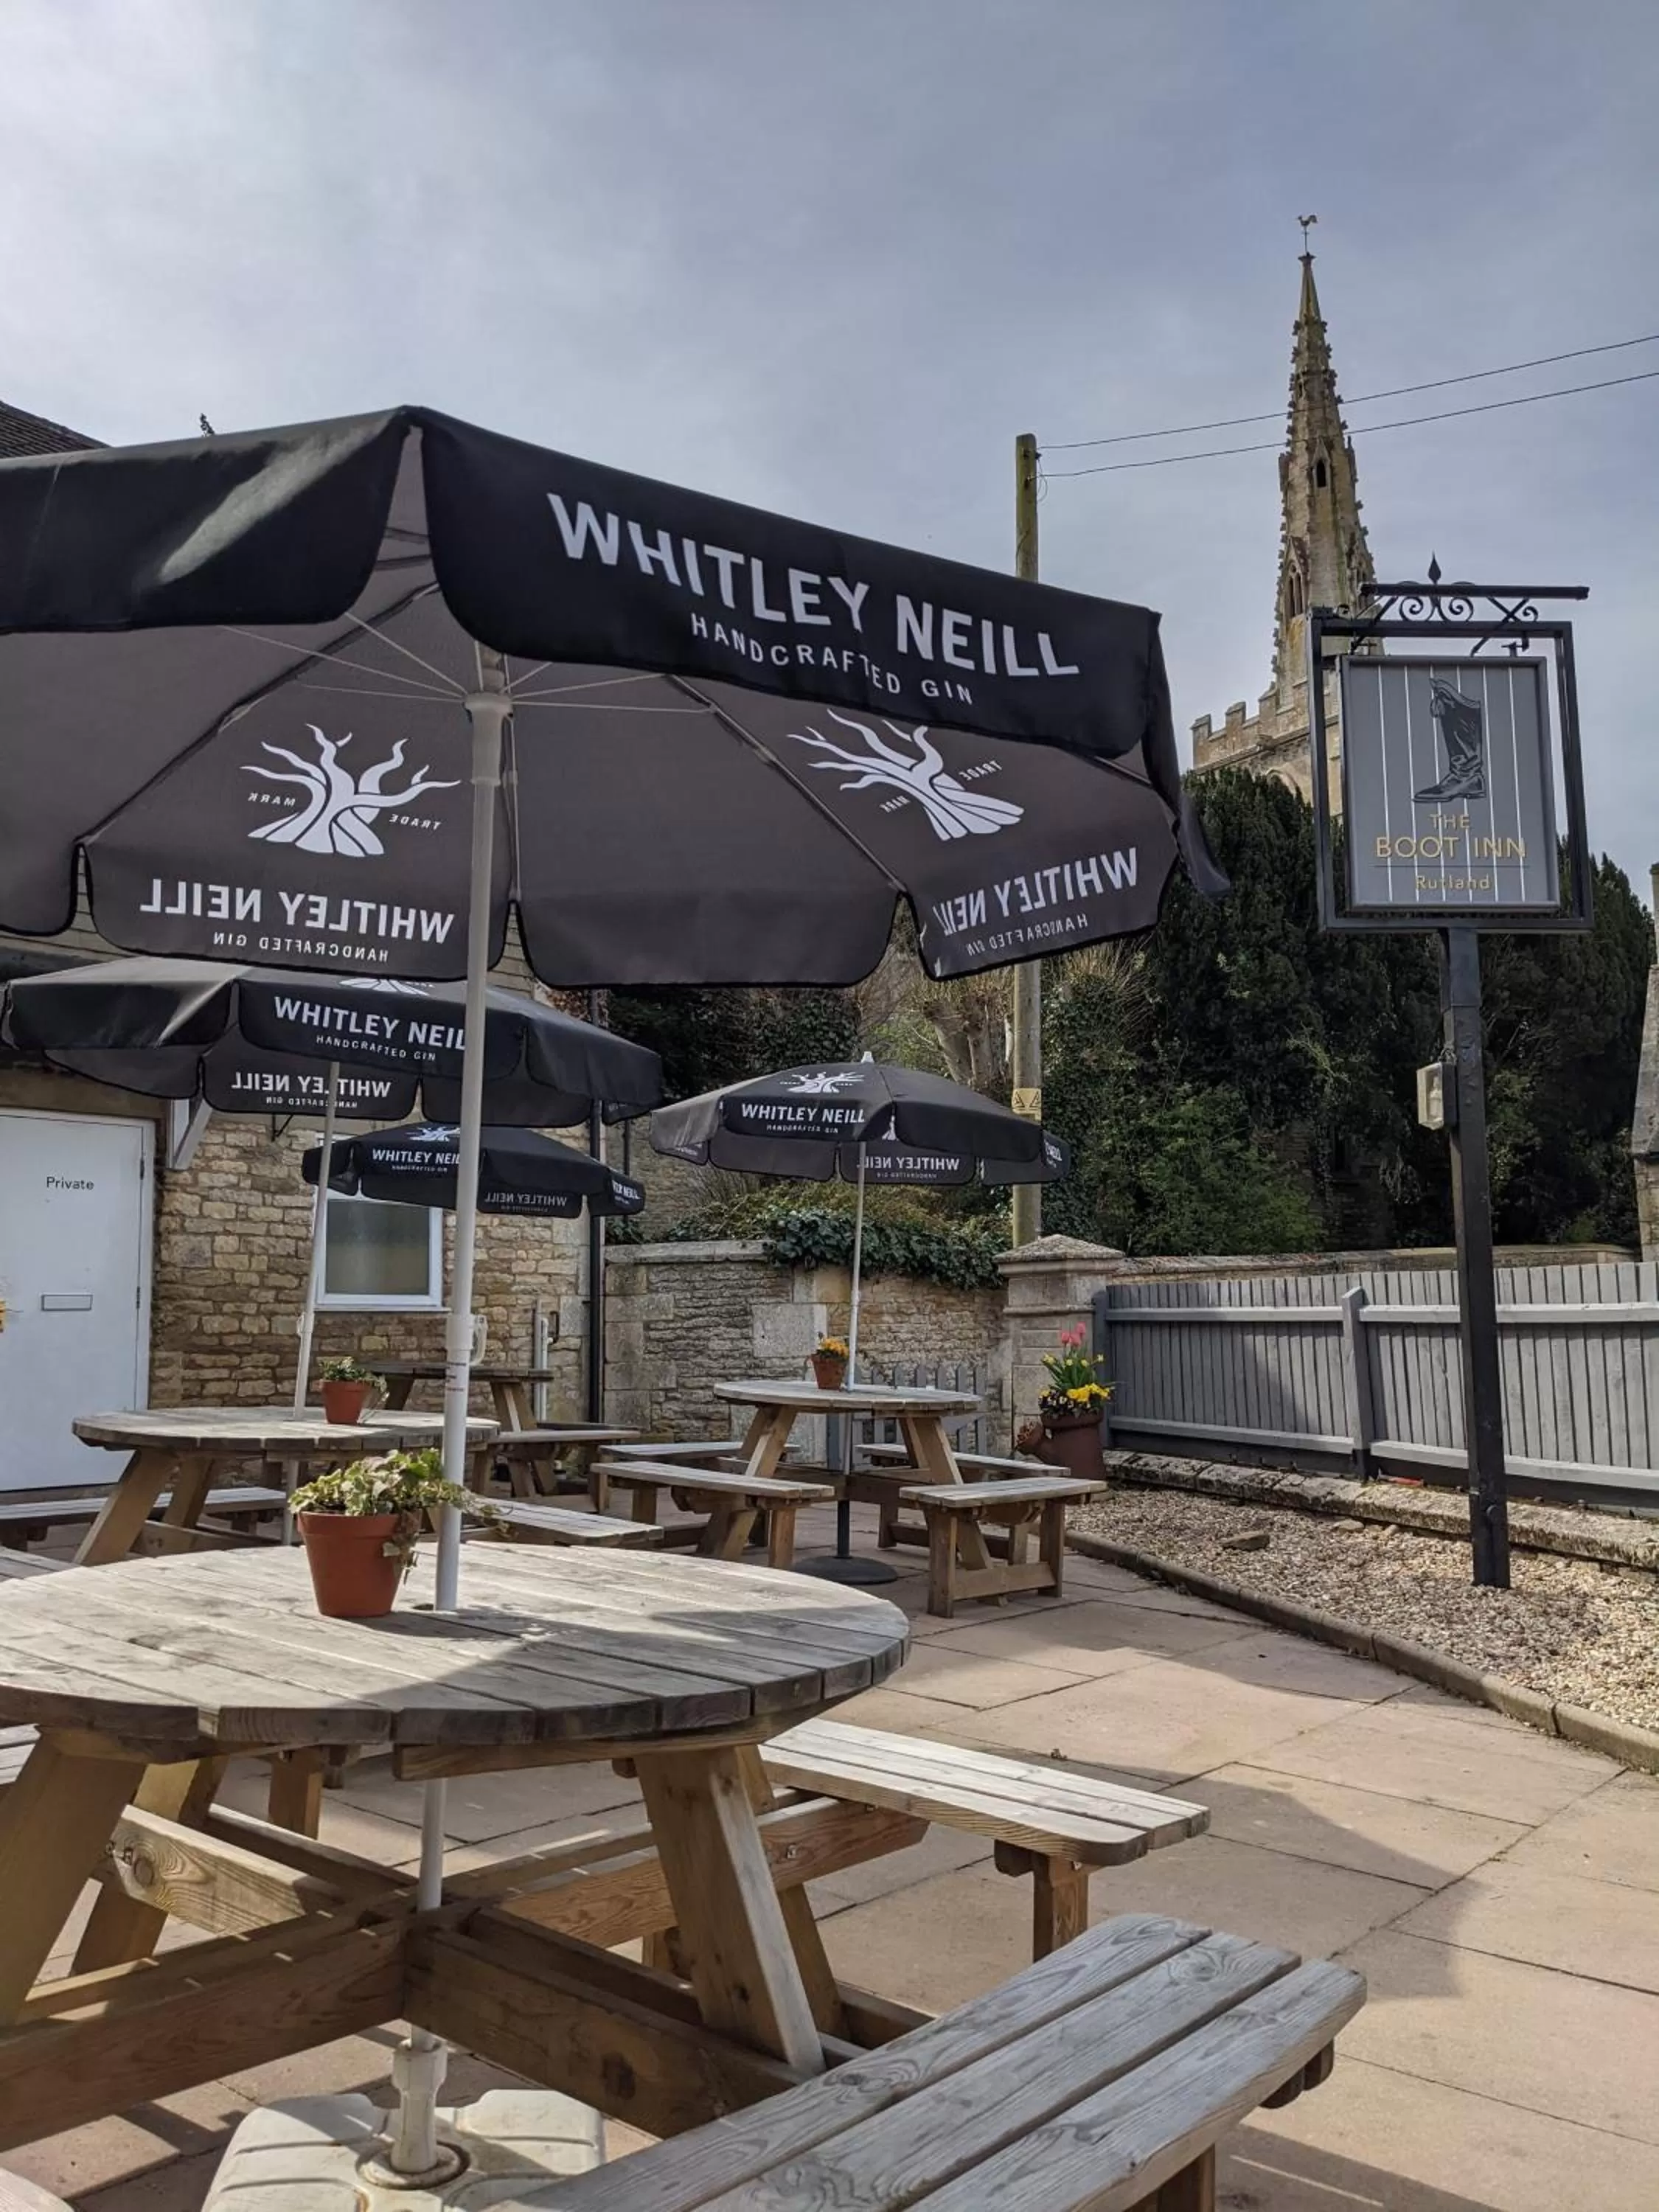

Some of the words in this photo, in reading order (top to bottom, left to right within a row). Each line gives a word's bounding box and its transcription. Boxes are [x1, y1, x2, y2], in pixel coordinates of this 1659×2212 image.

[546, 493, 870, 632] WHITLEY
[896, 594, 1079, 678] NEILL
[691, 613, 900, 694] HANDCRAFTED
[922, 680, 973, 705] GIN
[1430, 814, 1471, 830] THE
[1376, 837, 1459, 859] BOOT
[1474, 837, 1527, 859] INN
[1416, 874, 1491, 890] Rutland
[274, 996, 400, 1040] WHITLEY
[408, 1021, 466, 1051] NEIL
[316, 1034, 406, 1058] HANDCRAFTED
[414, 1051, 436, 1061] GIN
[742, 1104, 817, 1121] WHITLEY
[822, 1108, 865, 1124] NEILL
[372, 1148, 432, 1164] WHITLEY
[435, 1152, 460, 1164] NEIL
[46, 1177, 94, 1190] Private
